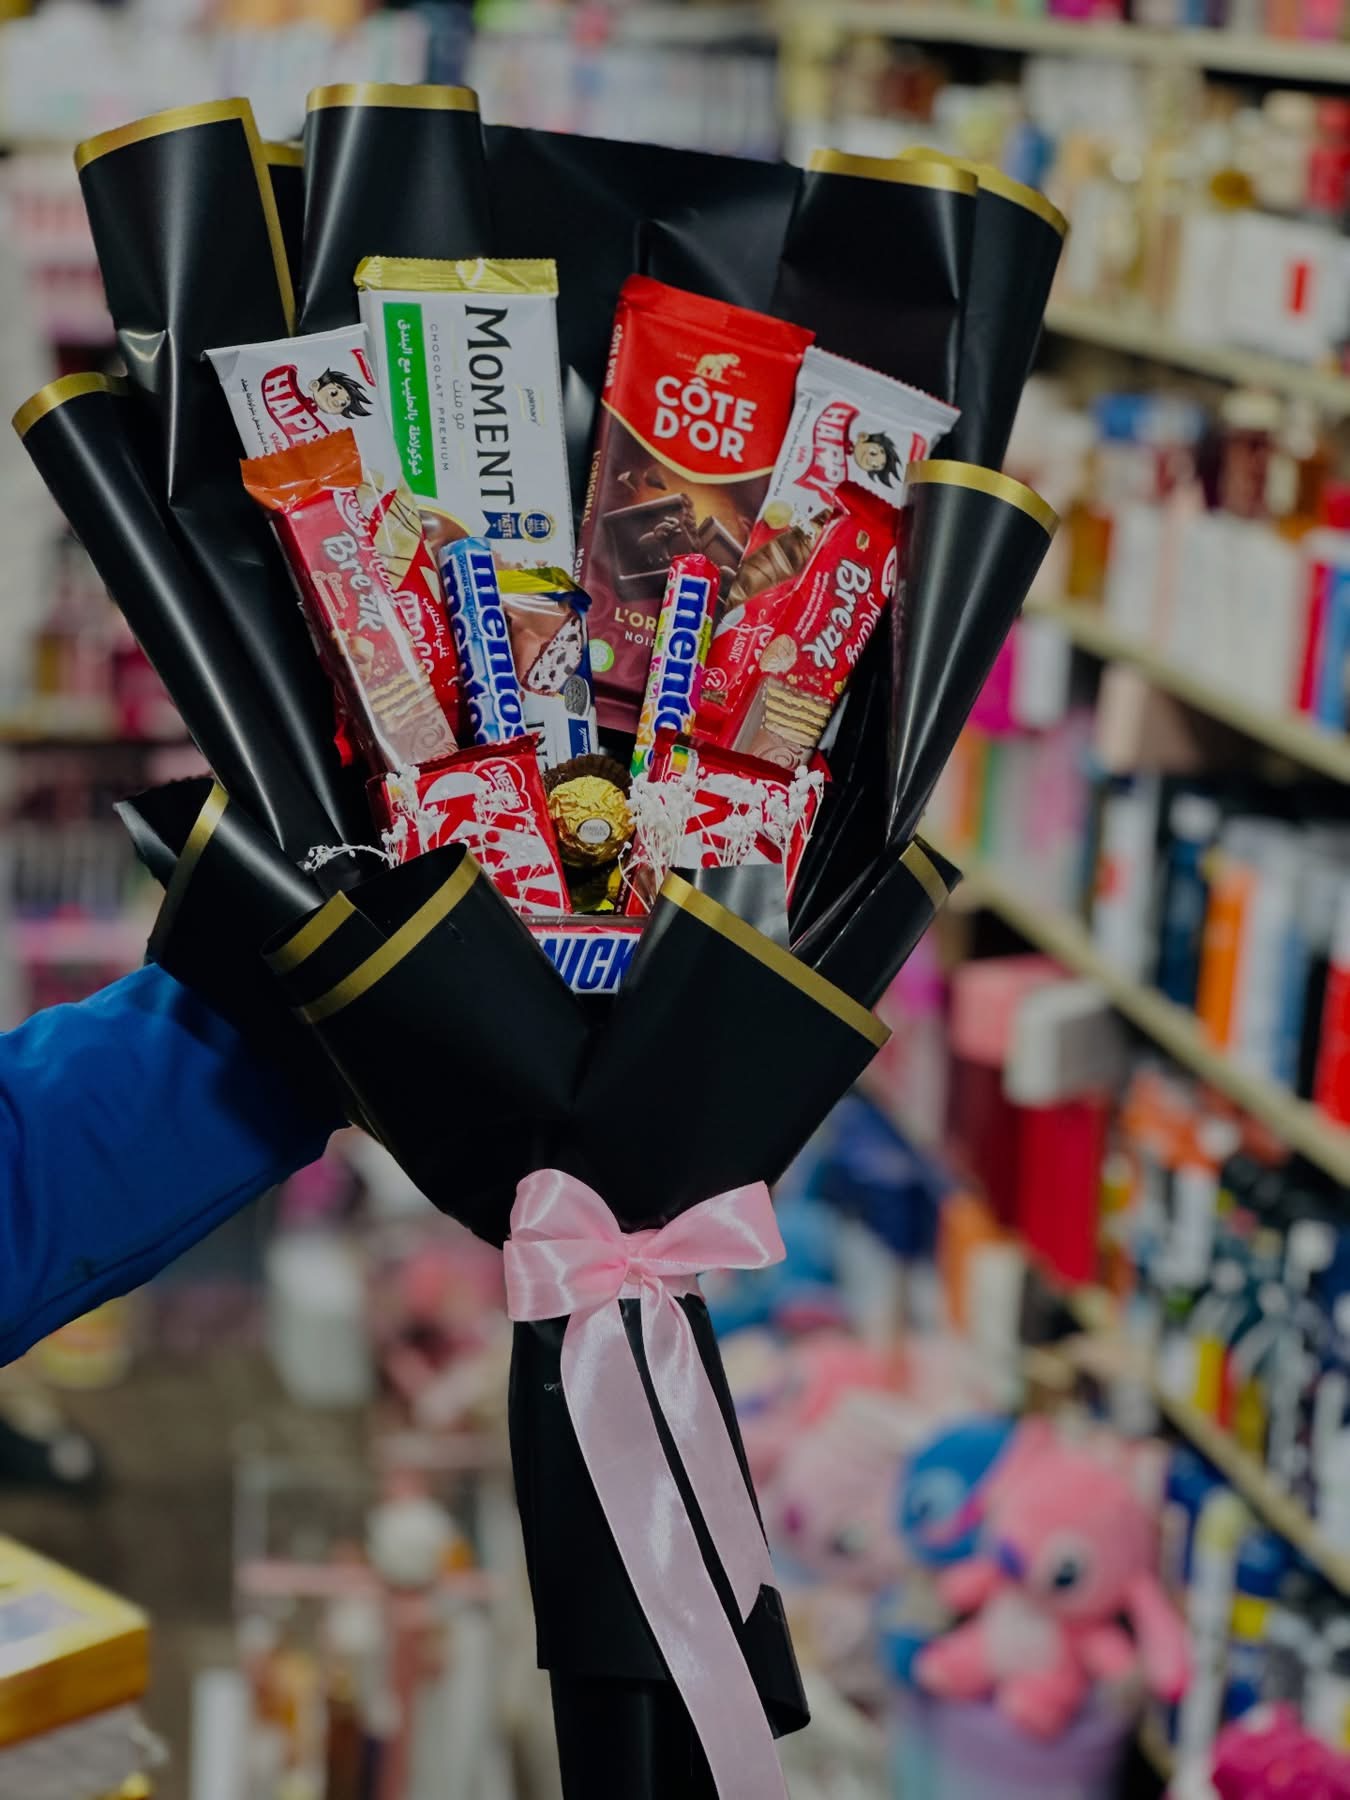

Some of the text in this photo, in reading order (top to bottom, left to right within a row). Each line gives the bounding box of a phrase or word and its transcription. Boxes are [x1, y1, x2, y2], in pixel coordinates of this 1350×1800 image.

[397, 319, 423, 476] شوكولاطة بالحليب مع البندق
[431, 324, 449, 471] CHOCOLAT PREMIUM
[465, 305, 514, 504] MOMENT
[653, 377, 758, 433] CÔTE
[653, 407, 744, 464] D'OR
[583, 451, 599, 525] L'ORIGINAL
[807, 407, 848, 496] HAPPY
[501, 513, 512, 538] TASTE
[323, 530, 380, 629] Break
[803, 560, 871, 668] Break
[728, 623, 749, 663] CLASSIC
